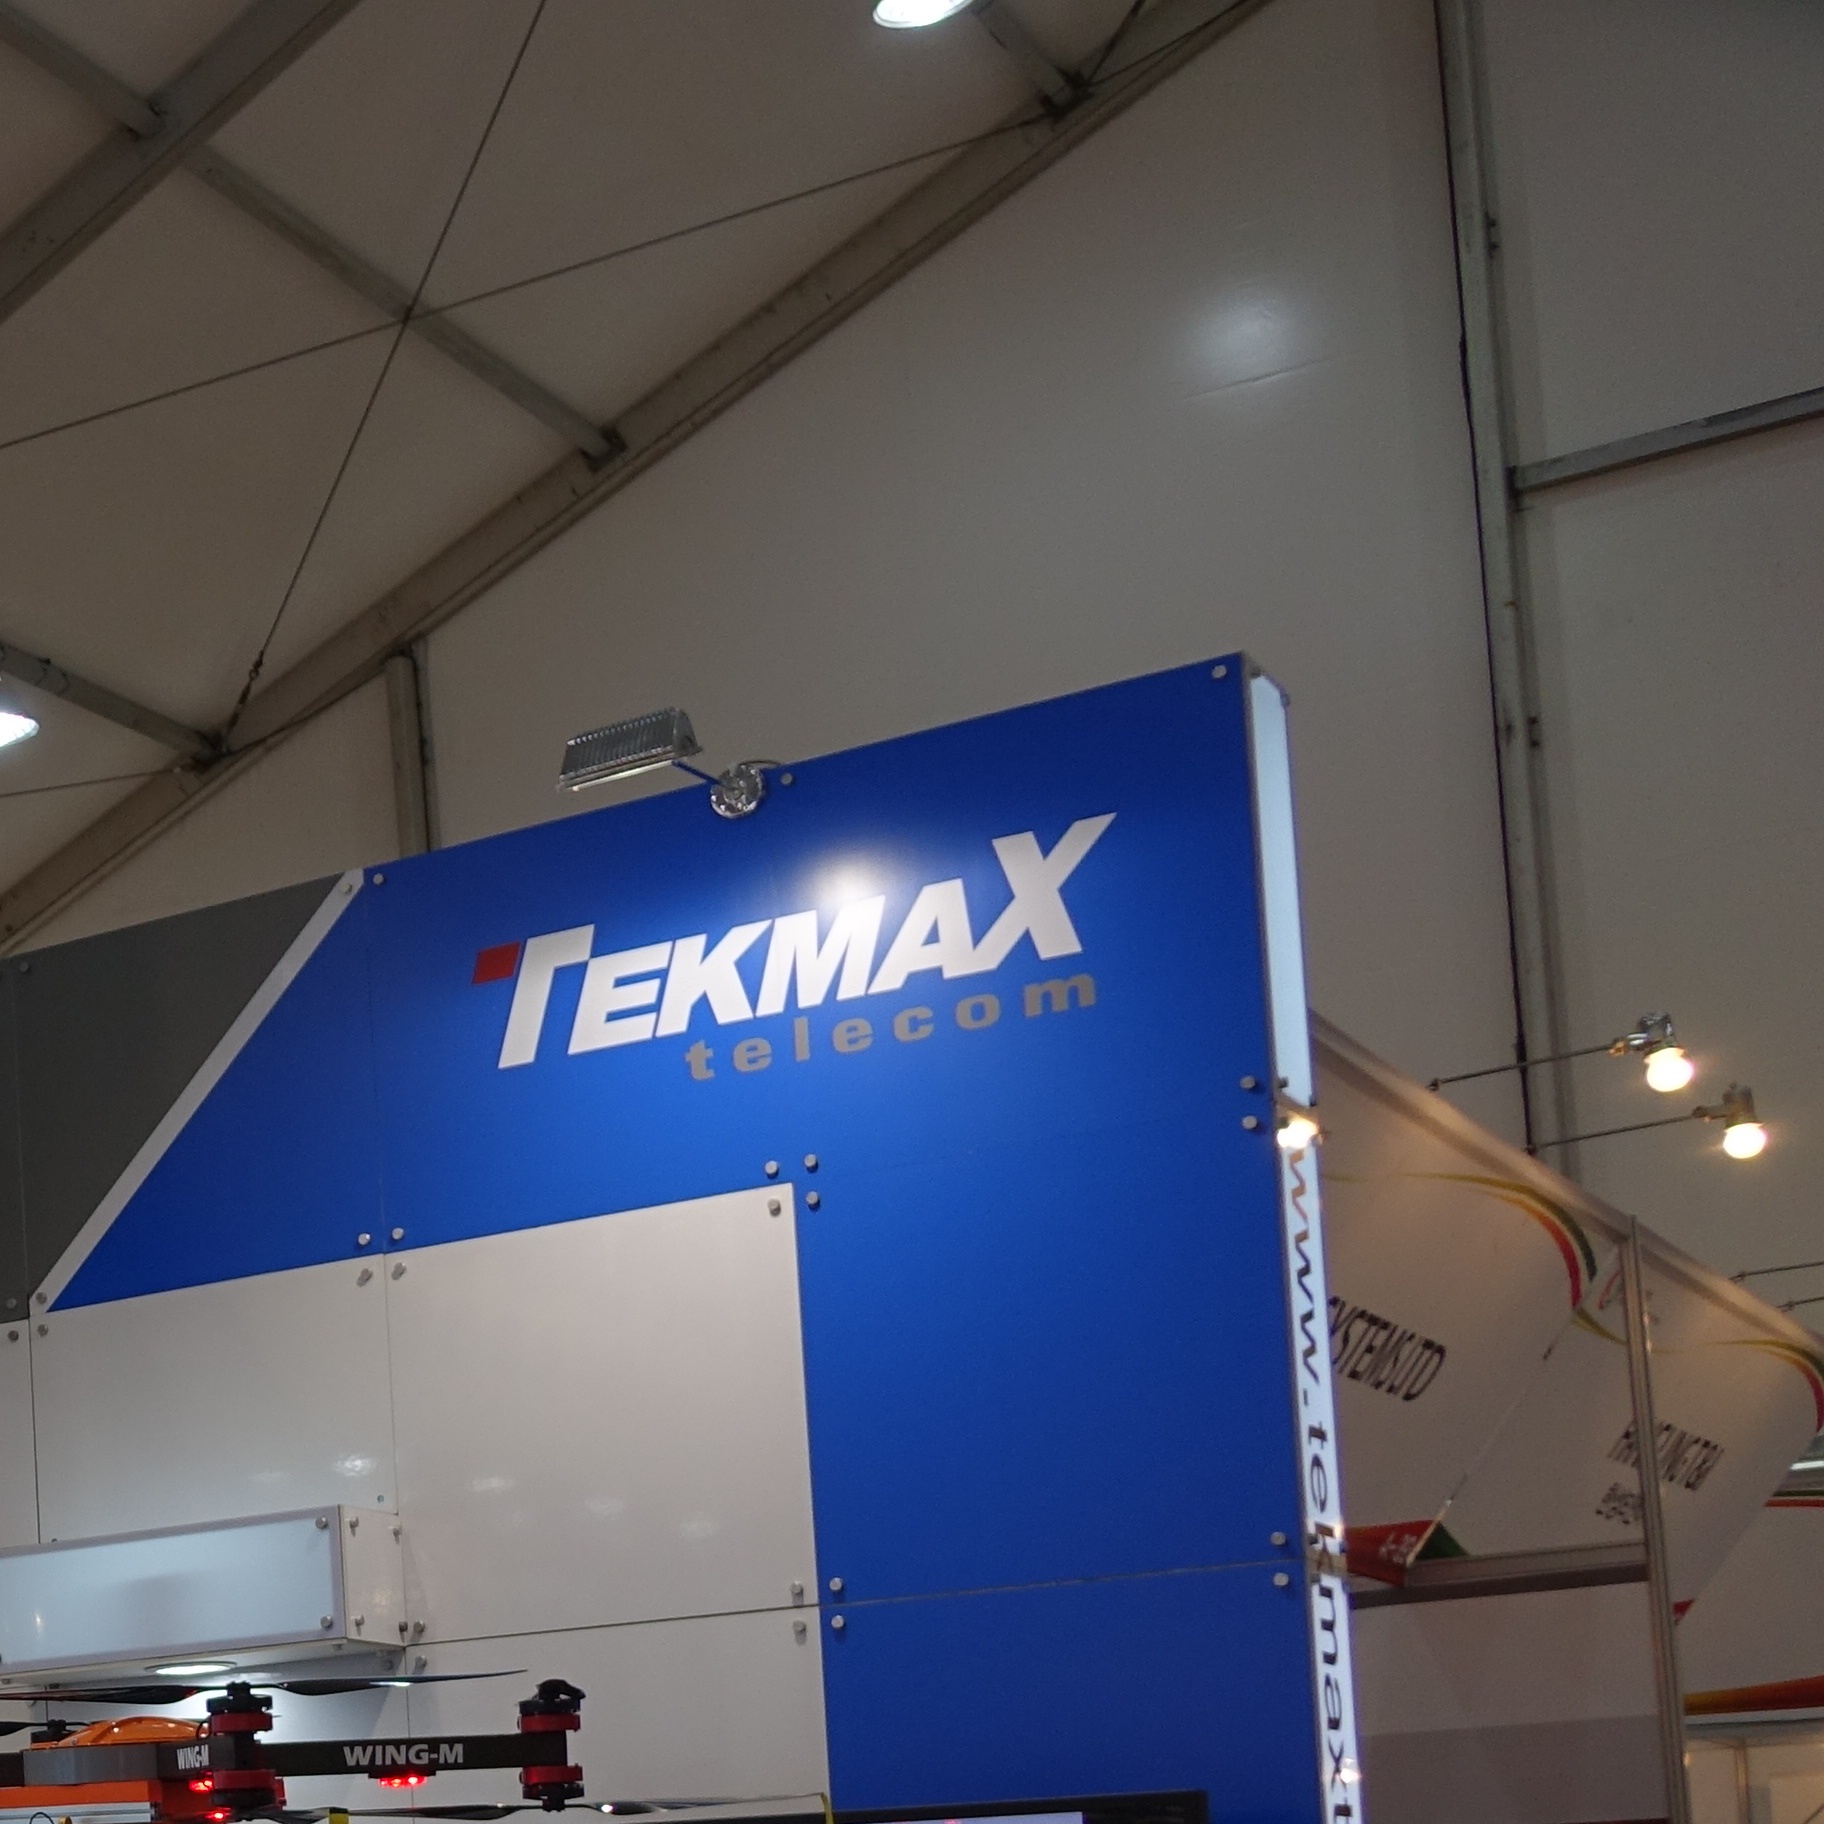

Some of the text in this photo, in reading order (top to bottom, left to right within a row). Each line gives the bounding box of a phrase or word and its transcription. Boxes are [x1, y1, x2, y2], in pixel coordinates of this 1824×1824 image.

[472, 812, 1118, 1069] TEKMAX
[686, 974, 1097, 1080] telecom
[176, 1744, 210, 1772] WING-M
[343, 1742, 464, 1767] WING-M
